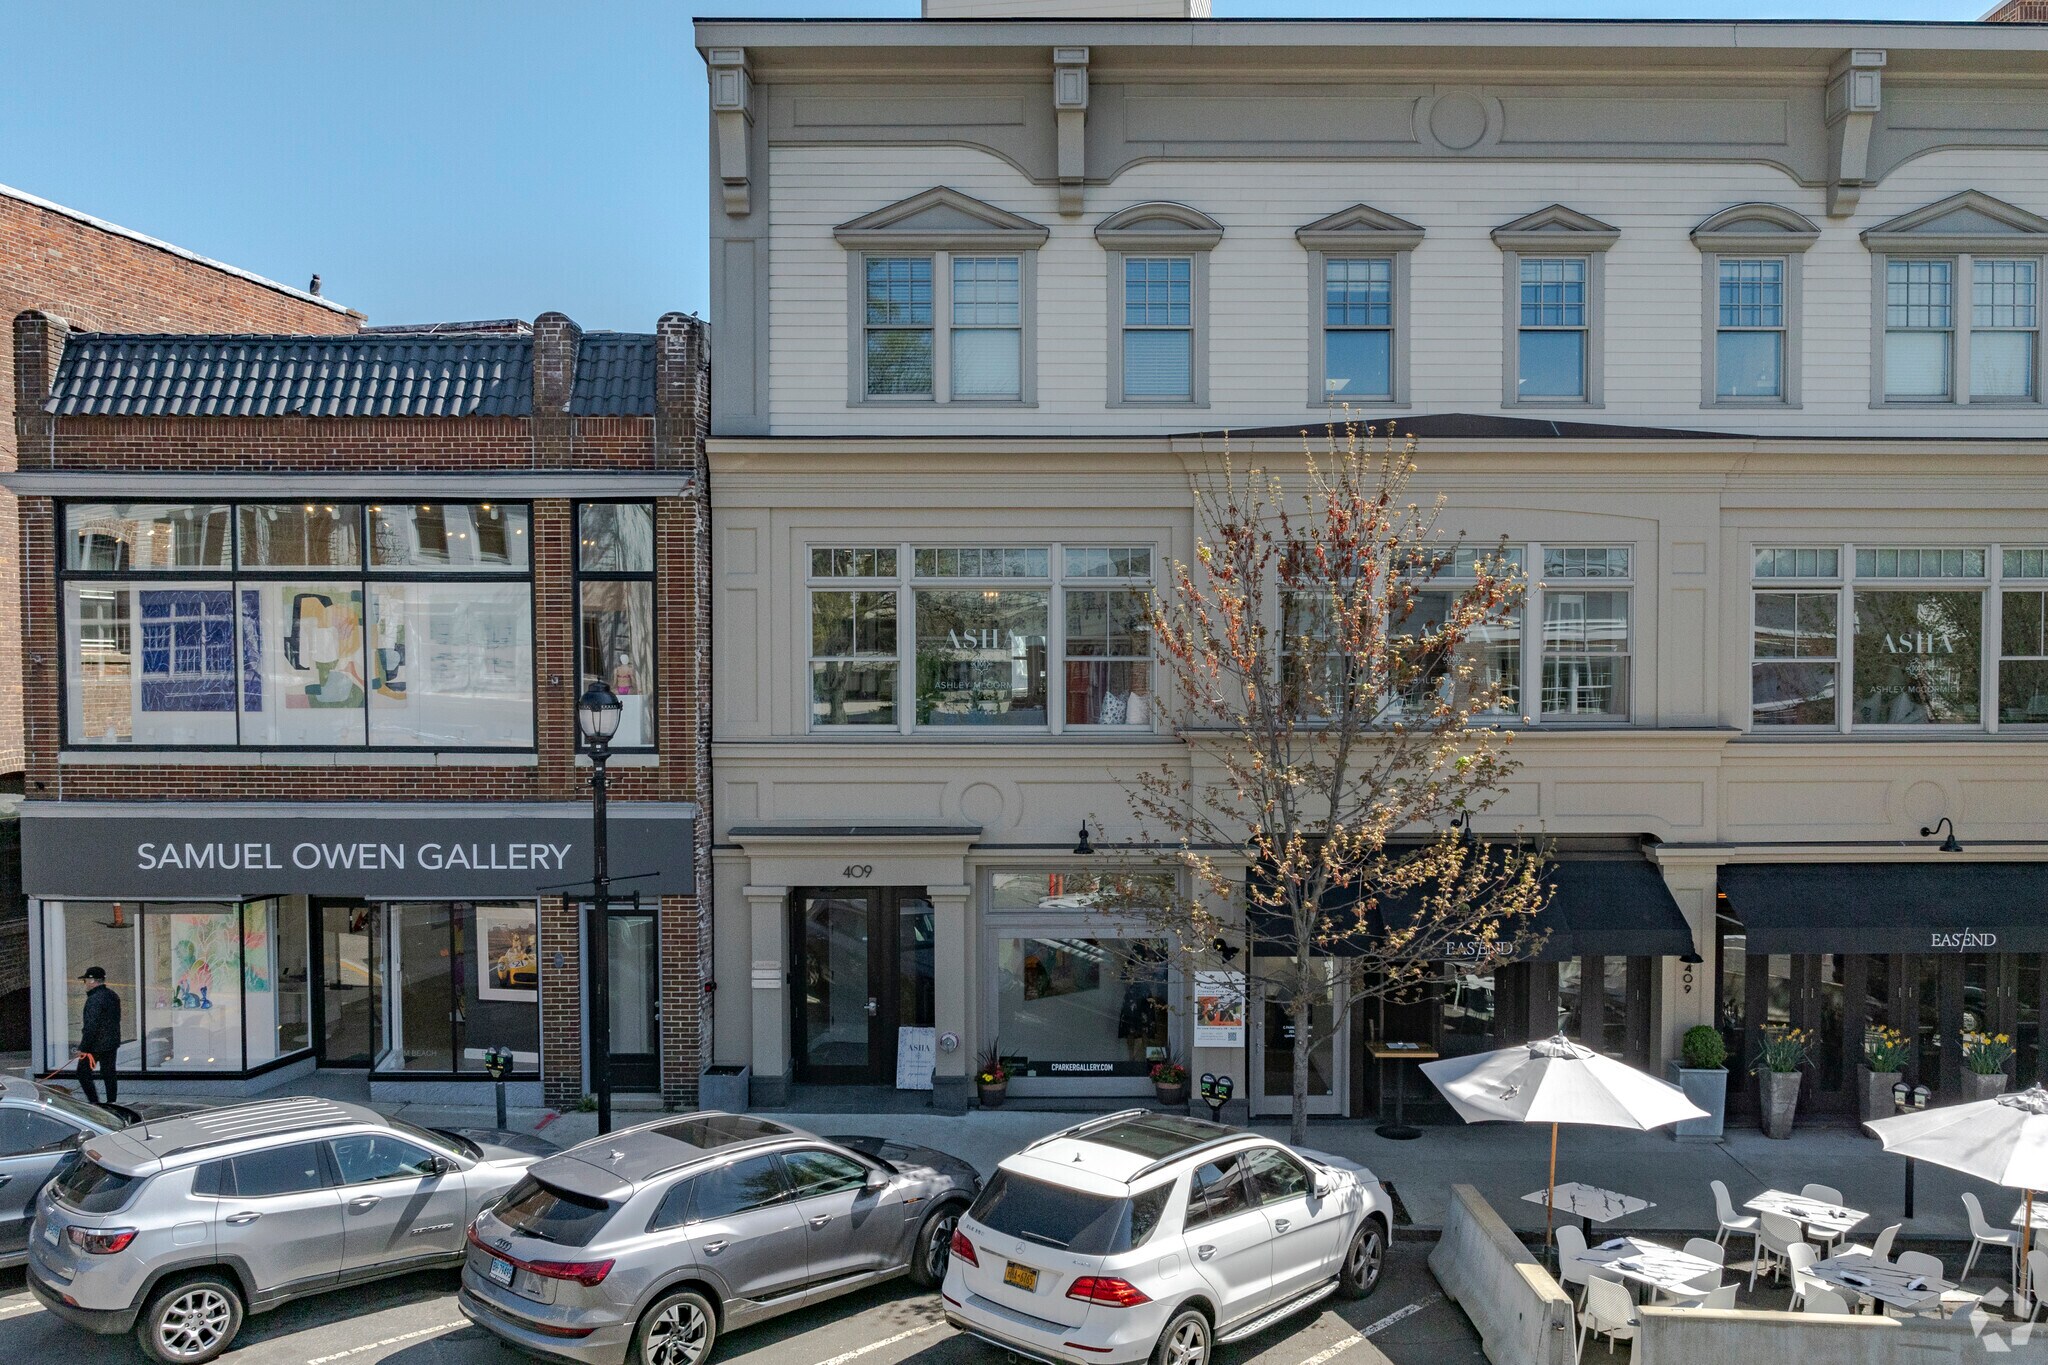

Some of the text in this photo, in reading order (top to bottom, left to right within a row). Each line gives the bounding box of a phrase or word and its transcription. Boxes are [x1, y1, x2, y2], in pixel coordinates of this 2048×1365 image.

[944, 628, 1020, 649] ASHA
[1879, 633, 1954, 653] ASHA
[934, 681, 971, 690] ASHLEY
[1869, 685, 1905, 693] ASHLEY
[137, 843, 572, 870] SAMUEL OWEN GALLERY
[842, 864, 873, 878] 409
[1682, 963, 1694, 994] 409
[908, 1044, 931, 1052] ASHA
[1051, 1063, 1114, 1071] CPARKERGALLERY.COM
